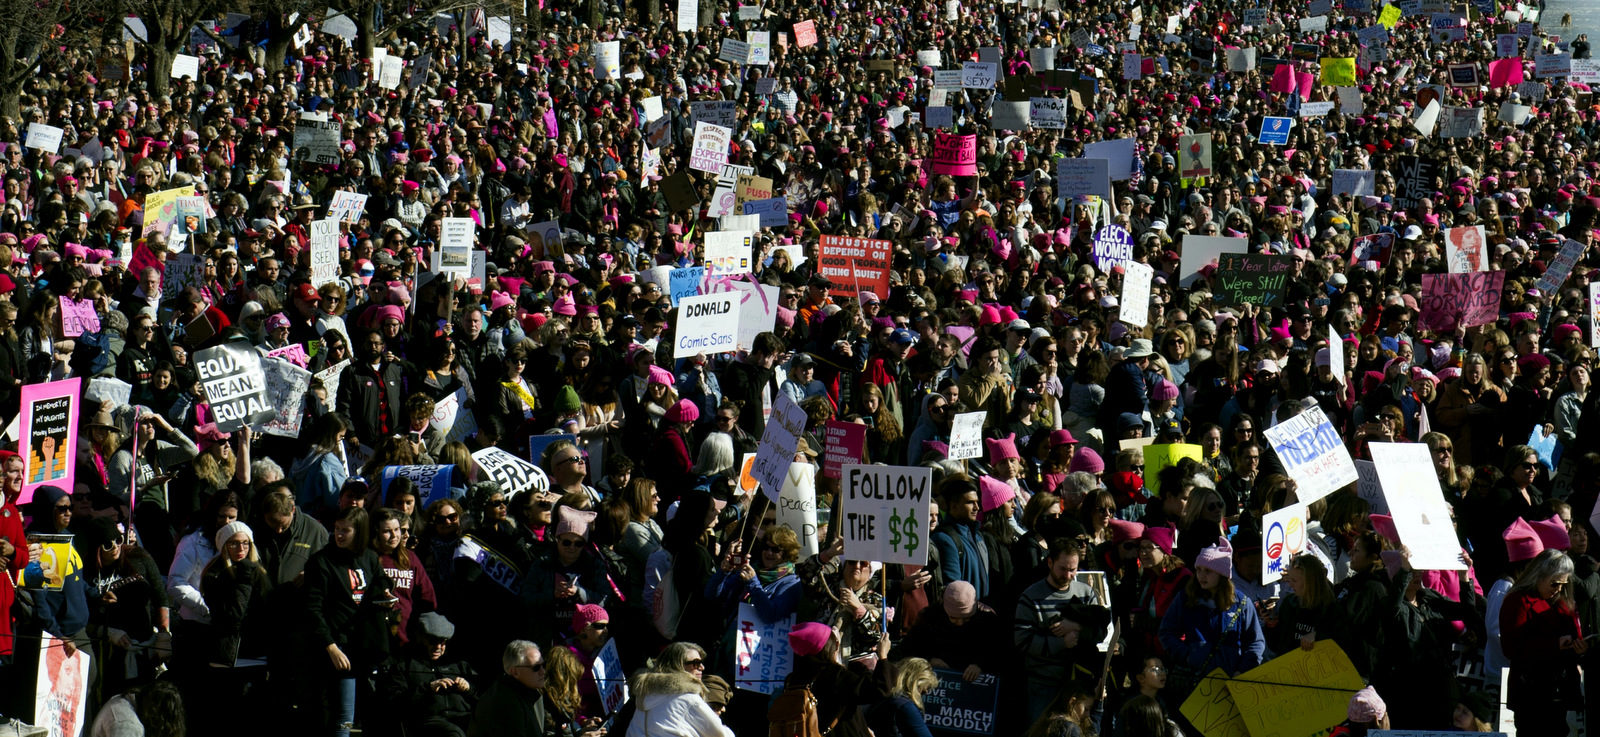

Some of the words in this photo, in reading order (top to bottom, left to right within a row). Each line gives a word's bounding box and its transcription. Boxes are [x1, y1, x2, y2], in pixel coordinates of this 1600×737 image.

[966, 76, 990, 87] SEXY
[320, 122, 340, 130] LIVE
[316, 154, 338, 164] SHIT
[695, 148, 724, 161] EXPECT
[1401, 157, 1431, 180] WE
[739, 176, 753, 187] MY
[1396, 177, 1430, 191] ARE
[179, 199, 201, 208] TIME
[332, 193, 363, 209] JUSTICE
[315, 221, 333, 235] YOU
[1101, 225, 1130, 244] ELECT
[826, 236, 889, 250] INJUSTICE
[1095, 240, 1134, 260] WOMEN
[314, 251, 334, 265] SEEN
[823, 247, 866, 257] DEPENDS
[872, 251, 886, 260] ON
[713, 256, 735, 272] US
[822, 257, 846, 266] GOOD
[854, 259, 887, 269] PEOPLE
[1226, 258, 1233, 271] 1
[1241, 258, 1264, 272] Year
[1268, 258, 1290, 272] Later
[822, 267, 850, 277] BEING
[855, 269, 882, 279] QUIET
[831, 283, 856, 292] PEAK
[1258, 274, 1285, 290] Still
[1431, 272, 1496, 297] MARCH
[1422, 289, 1500, 312] FORWARD
[686, 301, 731, 318] DONALD
[680, 334, 709, 349] Comic
[710, 332, 733, 345] Sans
[197, 353, 250, 379] EQUA
[213, 395, 272, 424] EQUAL
[830, 428, 847, 436] STAND
[1267, 427, 1288, 444] WE
[1301, 407, 1325, 428] NOT
[827, 436, 840, 445] WITH
[1275, 421, 1342, 469] TOLERATE
[826, 445, 849, 455] PLANNED
[825, 453, 859, 464] PARENTHOOD
[492, 459, 541, 491] ERA
[850, 469, 926, 503] FOLLOW
[847, 512, 875, 541] THE
[888, 507, 919, 557] $$
[384, 568, 413, 579] FUTURE
[938, 679, 961, 690] TICE
[1233, 648, 1349, 709] STRONGER
[940, 706, 993, 722] MARCH
[924, 714, 991, 732] PROUDLY
